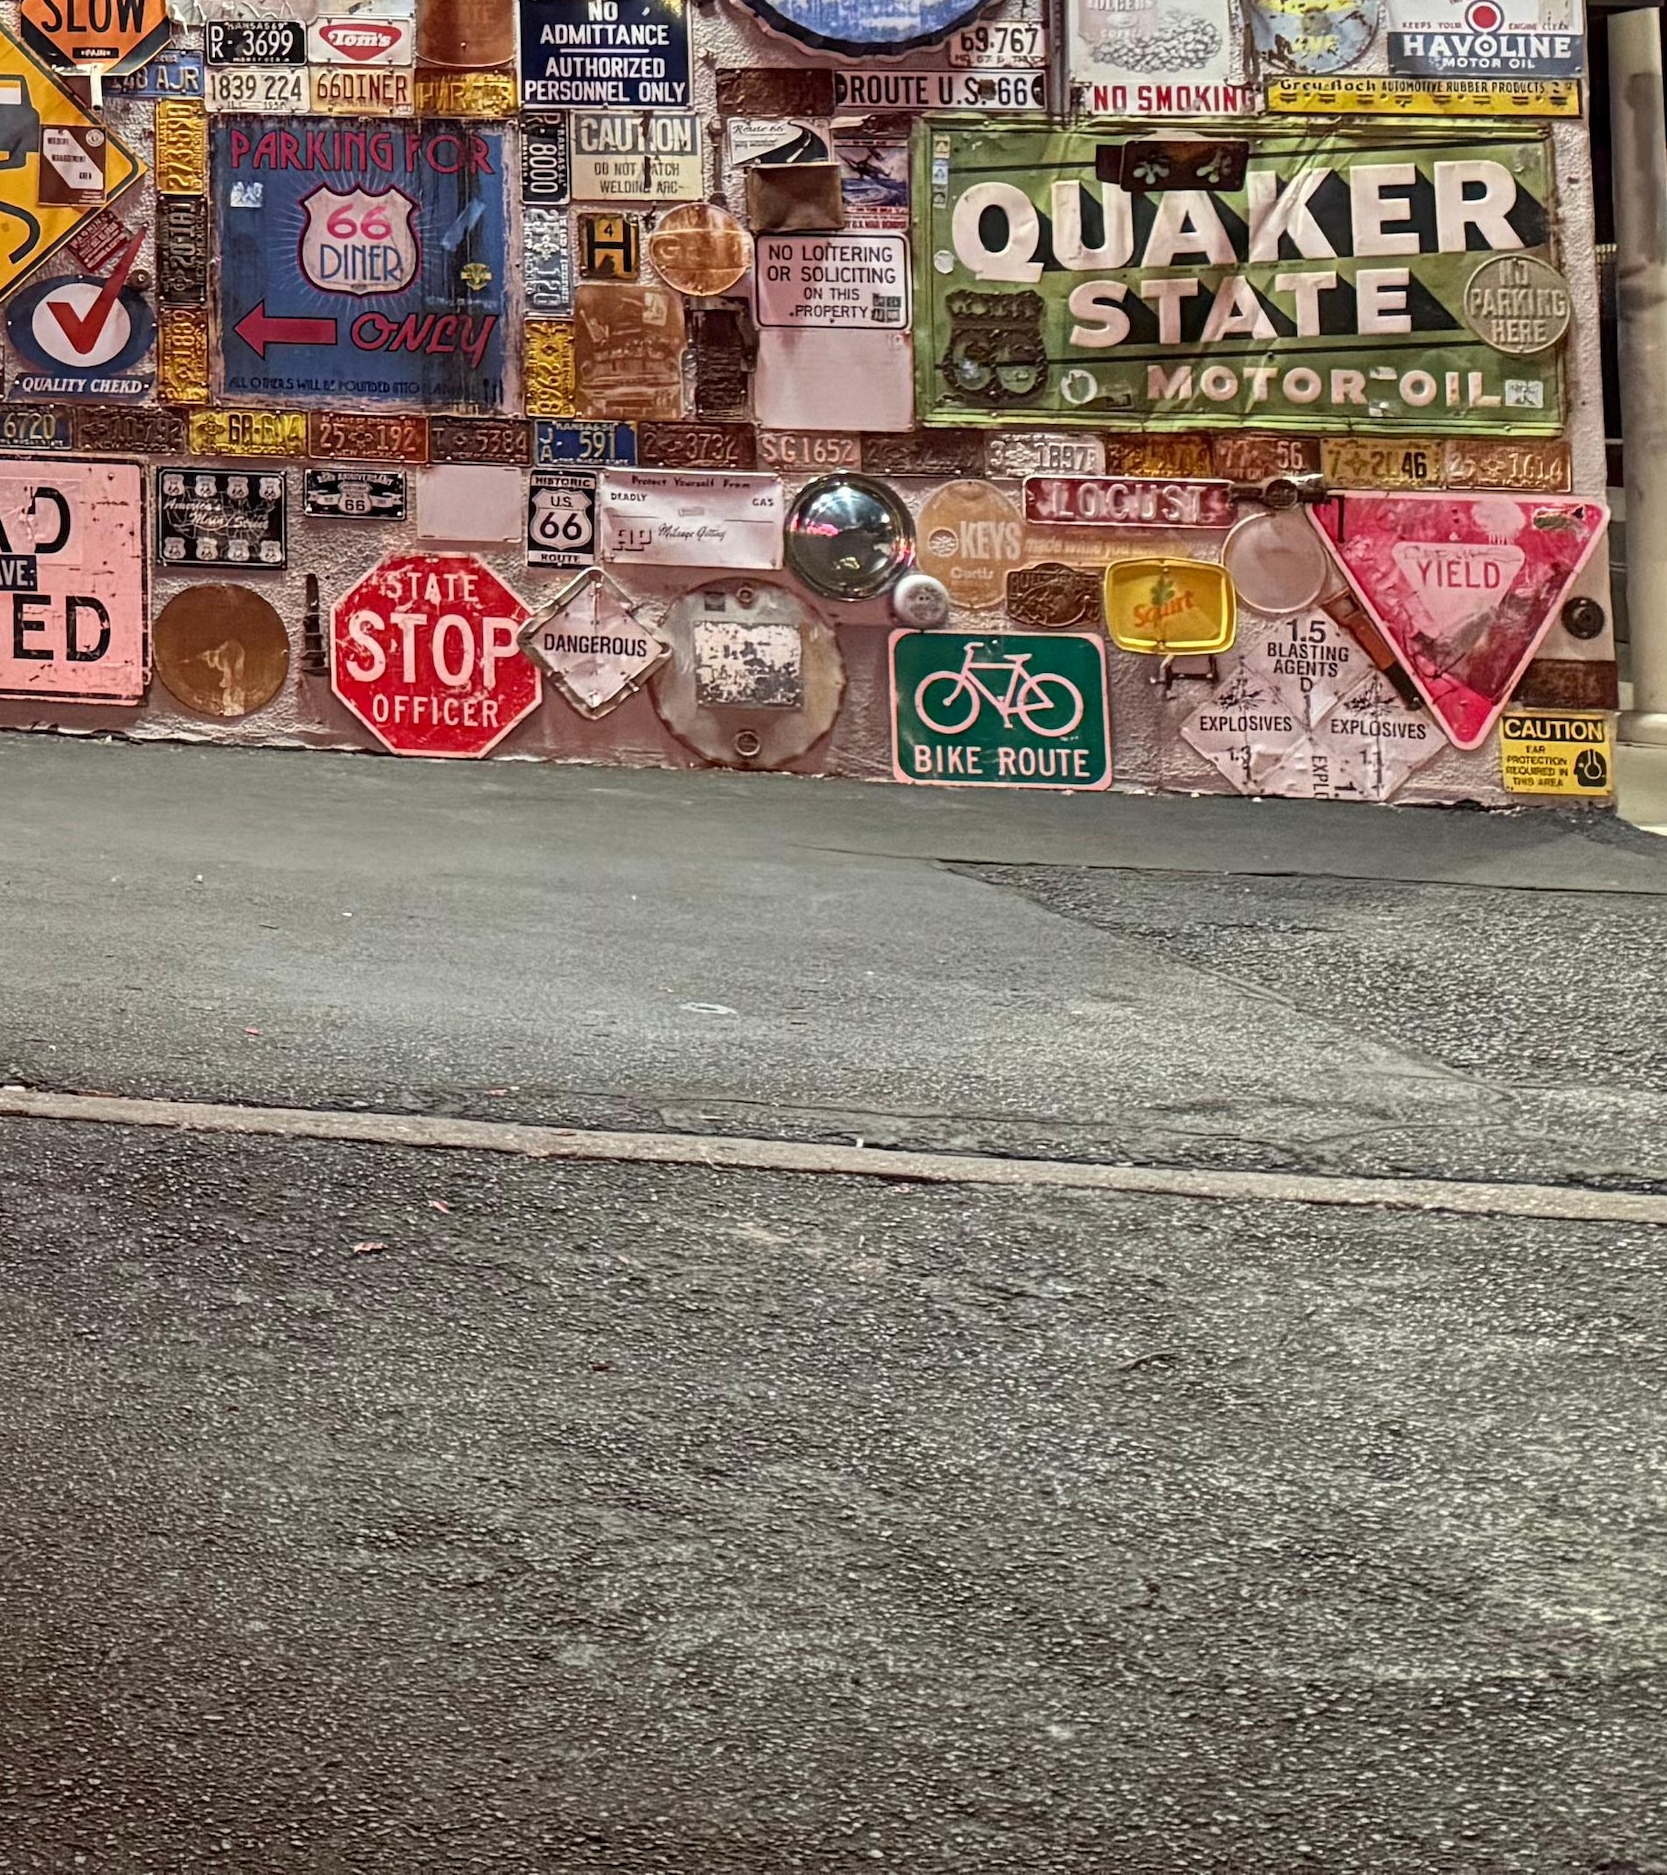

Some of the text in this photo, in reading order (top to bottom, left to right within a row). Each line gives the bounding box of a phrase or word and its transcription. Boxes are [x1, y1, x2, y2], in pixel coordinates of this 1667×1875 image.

[588, 0, 618, 22] NO
[540, 25, 669, 46] ADMITTANCE
[1403, 34, 1571, 59] HAVOLINE
[545, 57, 665, 78] AUTHORIZED
[1442, 58, 1535, 69] MOTOR OIL
[525, 81, 685, 103] PERSONNEL ONLY
[952, 160, 1526, 282] QUAKER
[768, 245, 893, 263] NO LOITERING
[767, 266, 896, 283] OR SOLICITING
[803, 287, 860, 301] ON THIS
[795, 304, 867, 318] PROPERTY
[1070, 268, 1413, 348] STATE
[22, 377, 142, 394] QUALITY CHEKD
[1147, 365, 1501, 408] MOTOR OIL
[611, 492, 774, 507] DEADLY GAS
[1418, 560, 1501, 589] YIELD
[386, 573, 479, 603] STATE
[346, 610, 521, 688] STOP
[544, 633, 647, 657] DANGEROUS
[373, 693, 499, 728] OFFICER
[1504, 721, 1603, 741] CAUTION
[914, 746, 1089, 778] BIKE ROUTE
